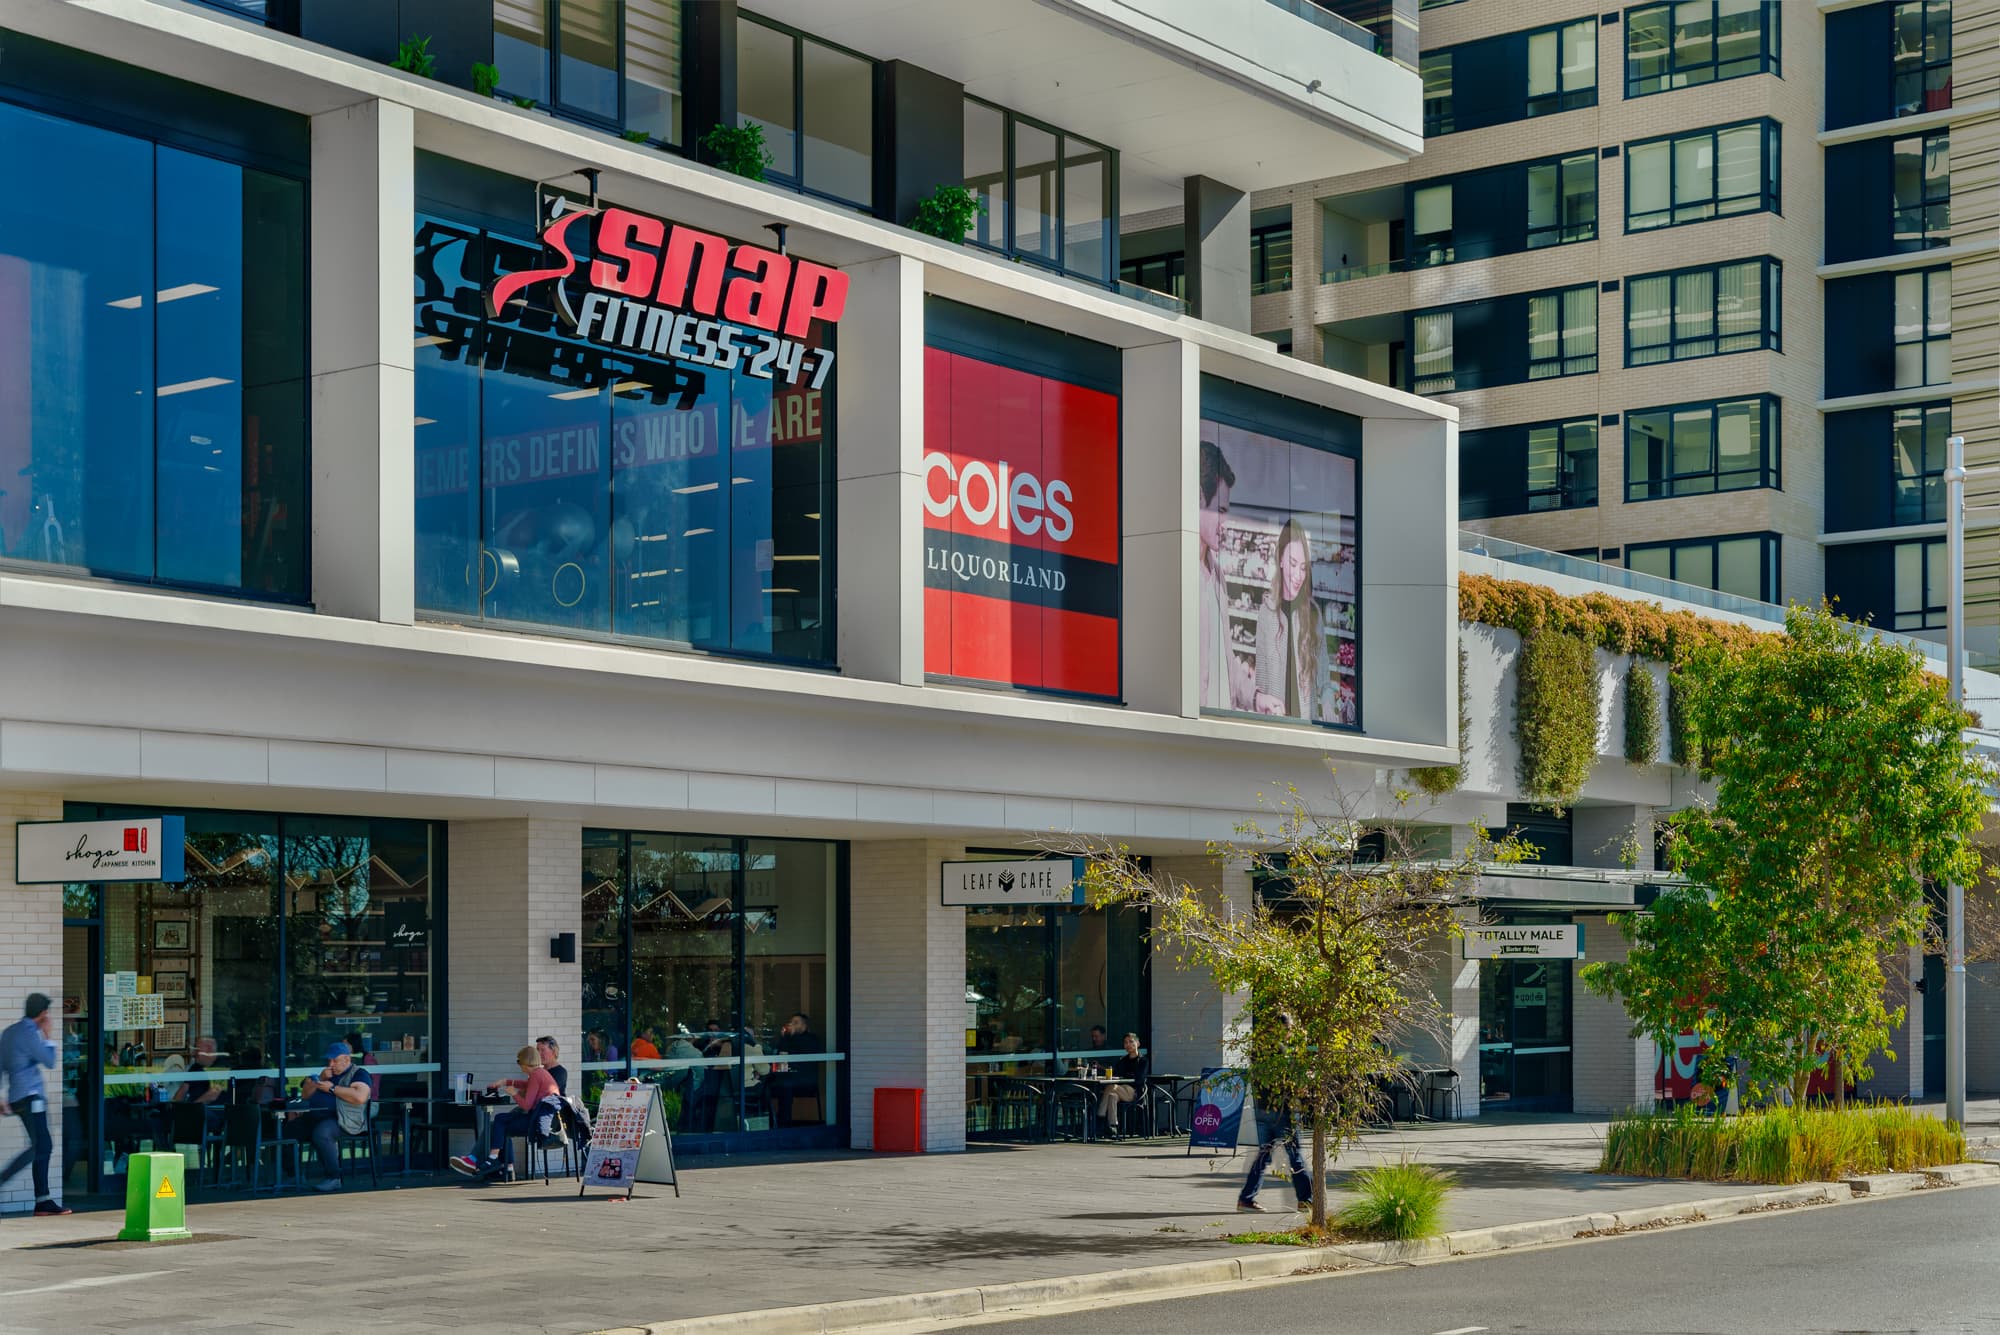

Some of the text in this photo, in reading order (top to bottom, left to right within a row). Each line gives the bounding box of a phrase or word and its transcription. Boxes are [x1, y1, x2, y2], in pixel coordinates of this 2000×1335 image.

[644, 410, 705, 461] WHO
[765, 391, 821, 442] ARE
[923, 451, 1074, 542] coles
[927, 547, 1066, 591] LIQUORLAND
[65, 833, 120, 868] shoga
[100, 860, 129, 868] JAPANESE
[963, 867, 1052, 890] LEAF CAFÉ
[1530, 930, 1564, 941] MALE
[1194, 1116, 1221, 1127] OPEN
